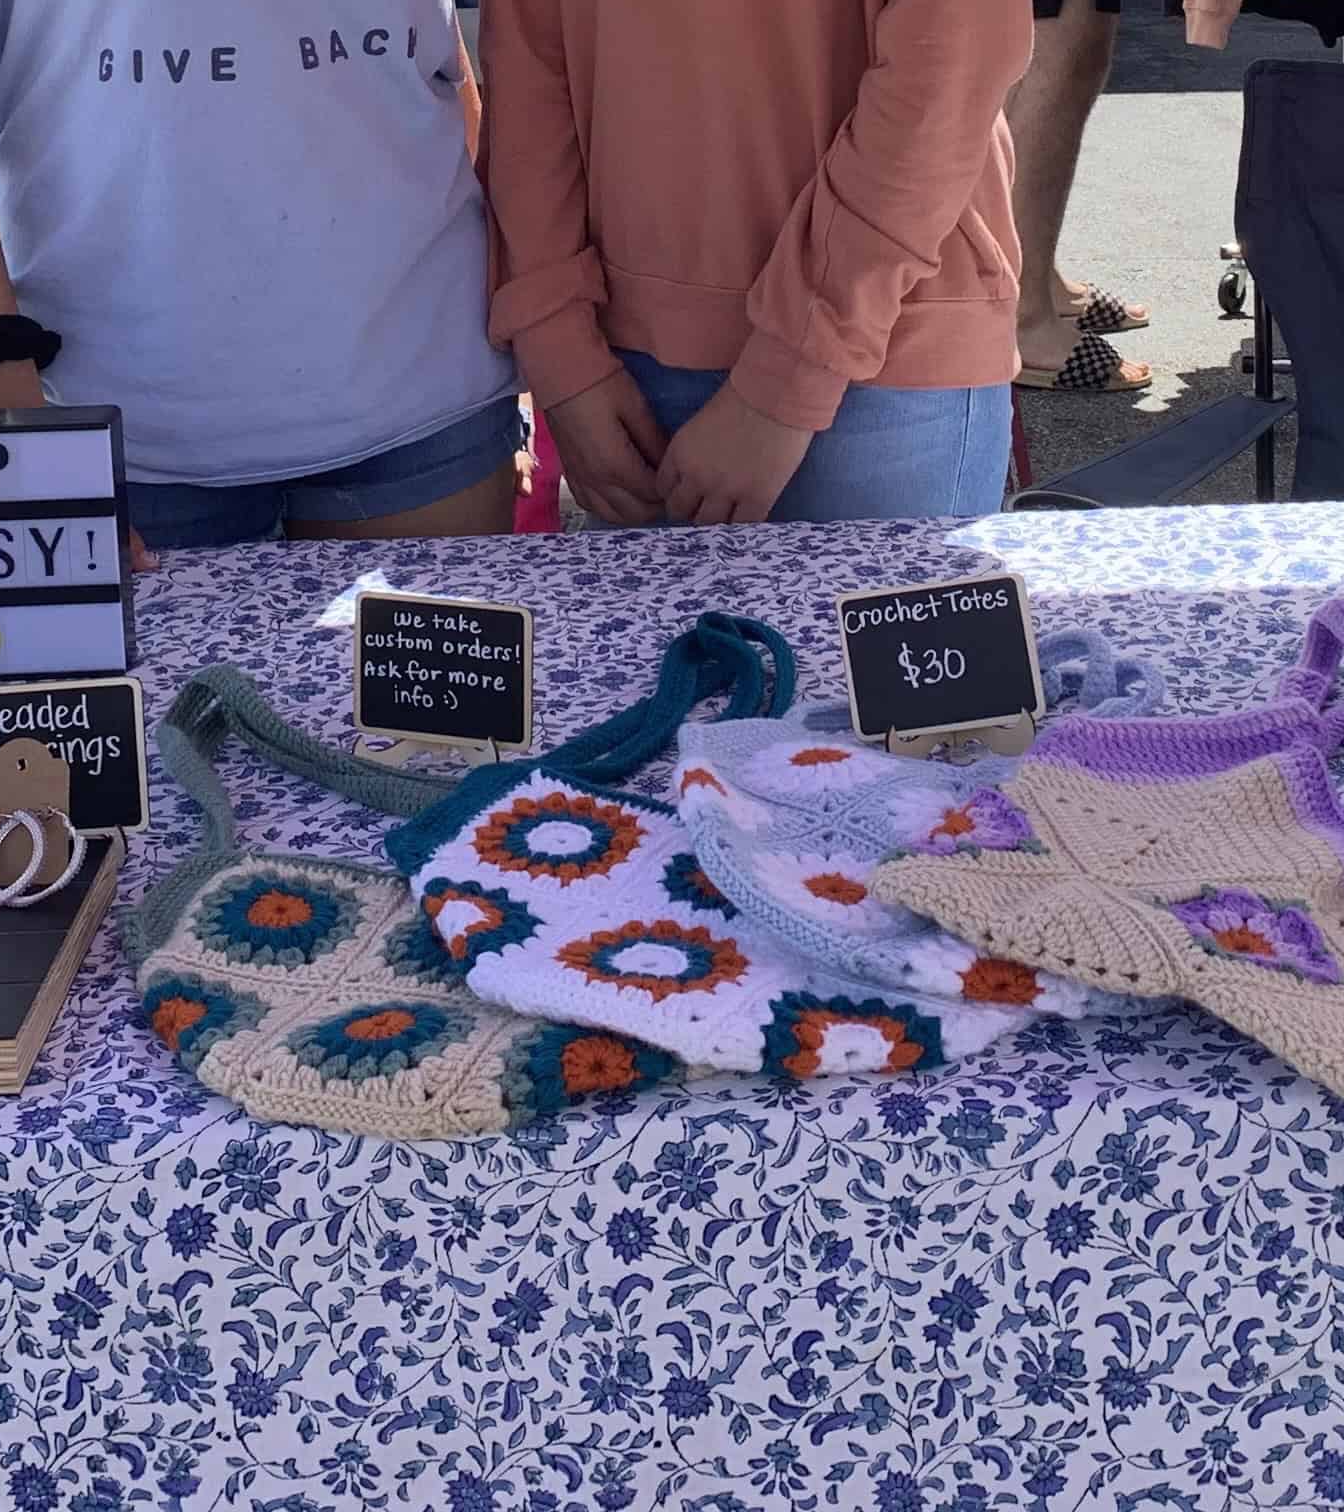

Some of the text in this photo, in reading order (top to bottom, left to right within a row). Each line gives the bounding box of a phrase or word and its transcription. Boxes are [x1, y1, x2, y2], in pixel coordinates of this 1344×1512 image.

[99, 47, 237, 84] GIVE
[393, 611, 483, 635] We take
[844, 587, 1009, 634] Crochet Totes
[364, 631, 522, 664] custom orders!
[363, 660, 507, 692] Ask for more
[898, 641, 966, 688] $30
[394, 684, 434, 708] info
